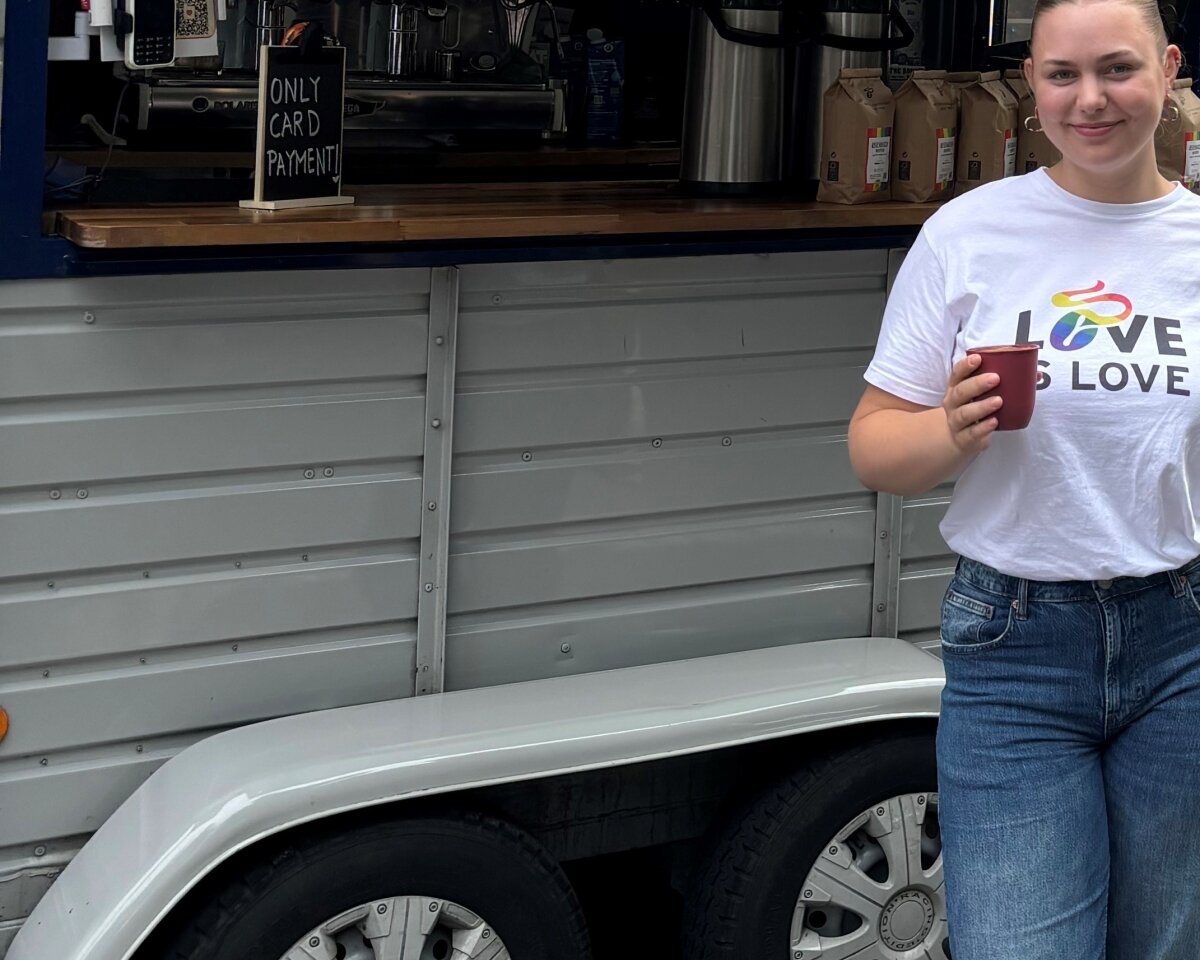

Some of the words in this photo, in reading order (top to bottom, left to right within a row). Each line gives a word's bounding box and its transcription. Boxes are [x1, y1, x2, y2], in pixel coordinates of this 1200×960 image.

[270, 76, 321, 105] ONLY
[269, 109, 320, 138] CARD
[1014, 280, 1187, 357] LOVE
[1071, 360, 1191, 397] LOVE
